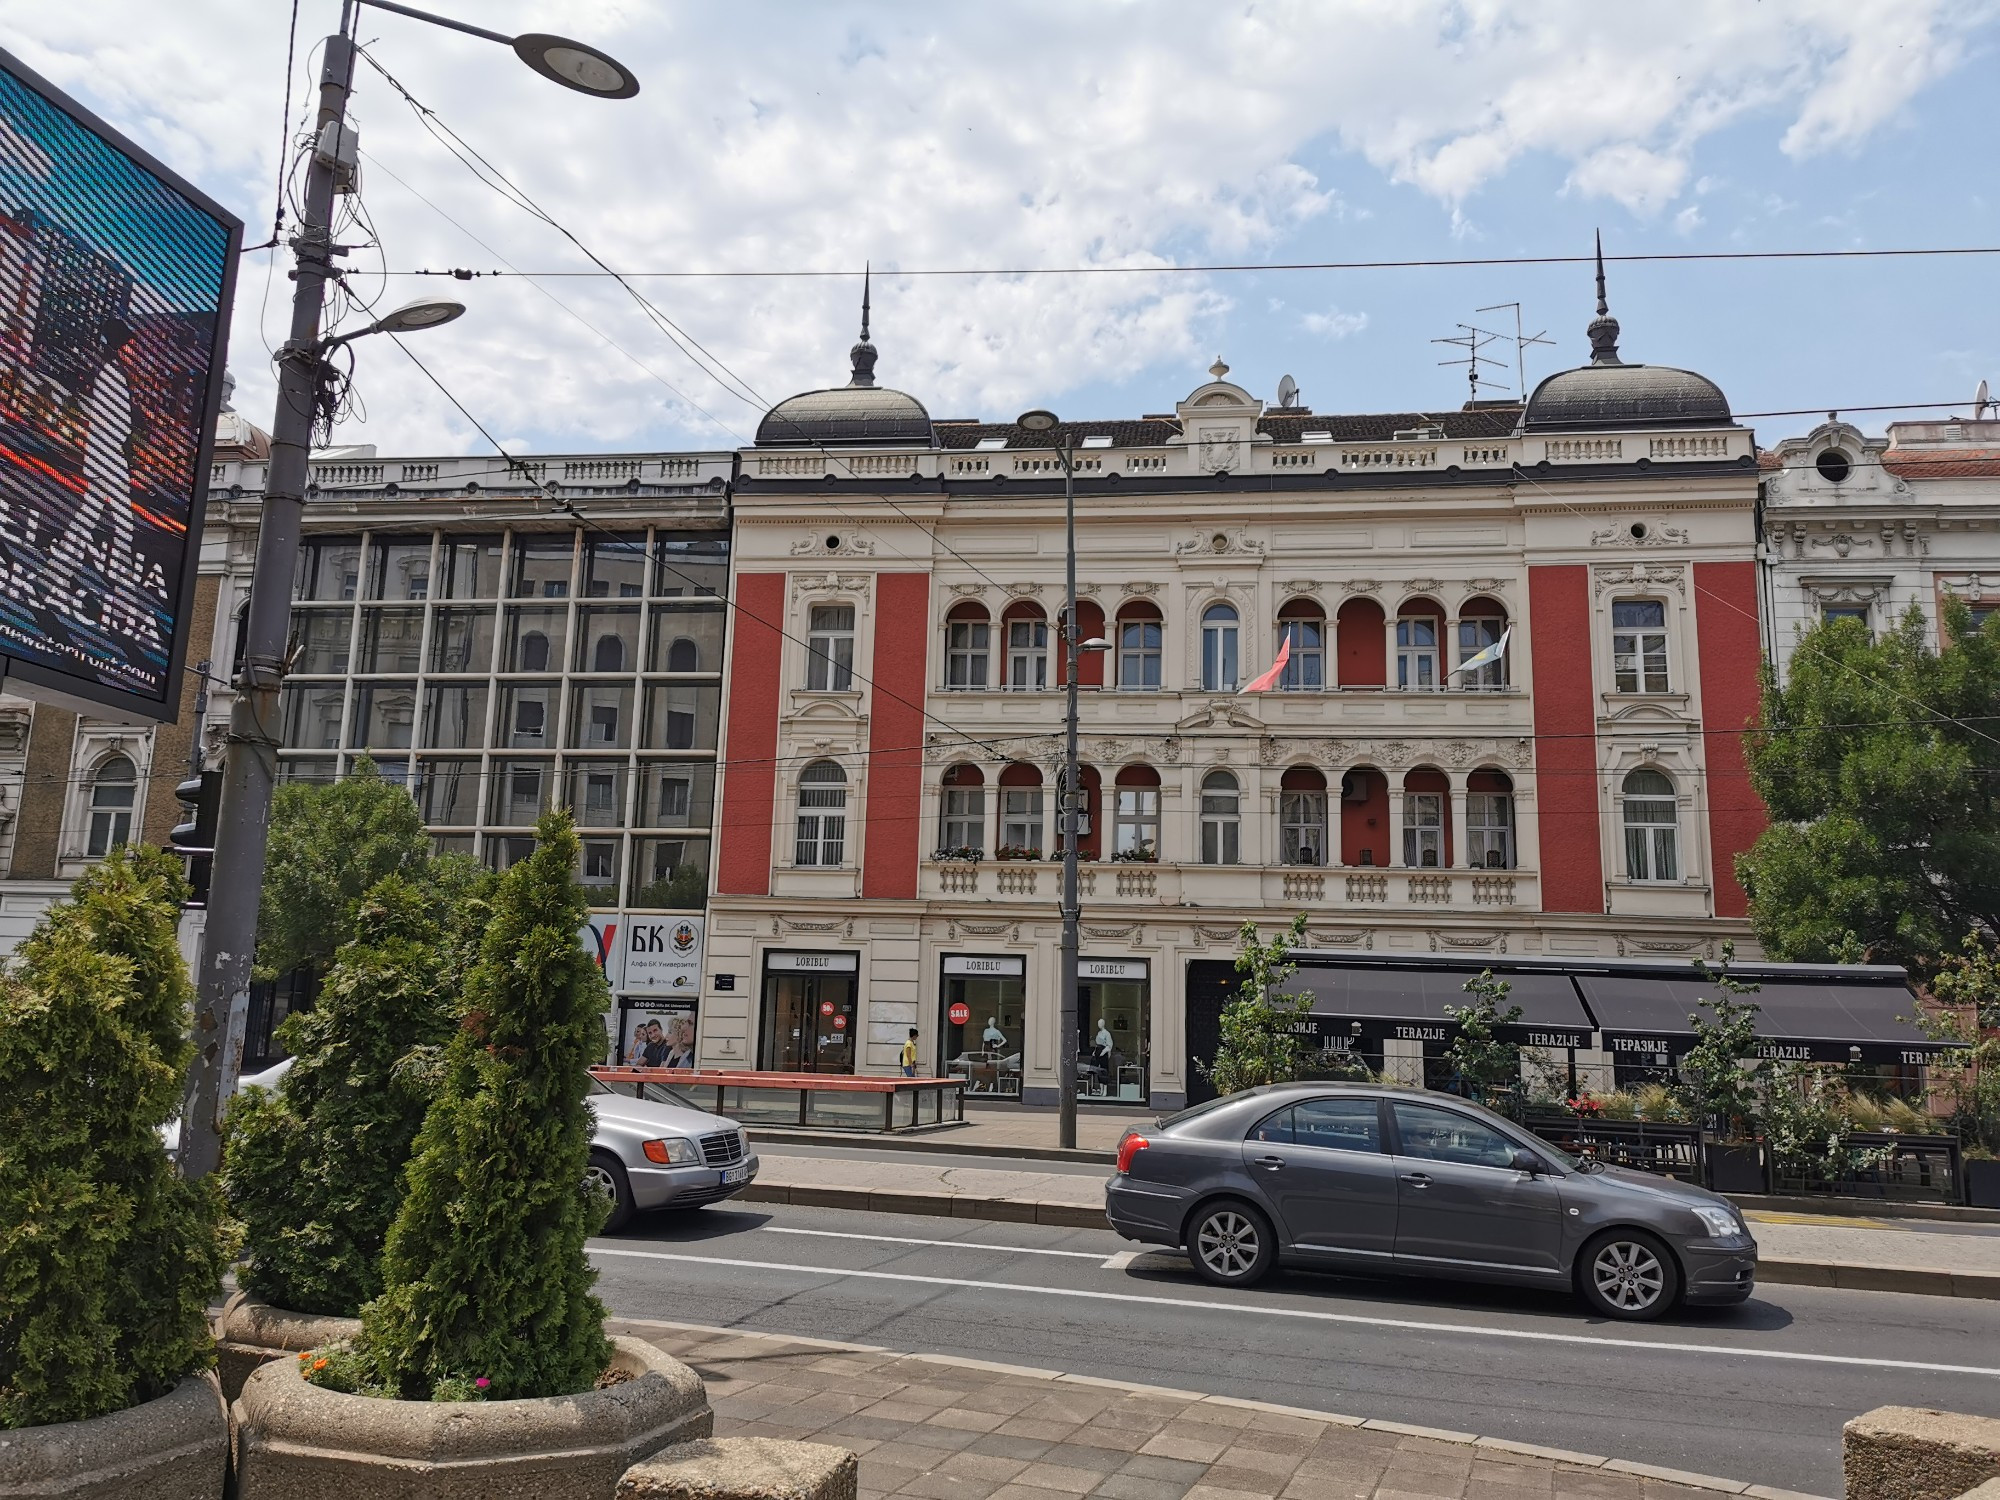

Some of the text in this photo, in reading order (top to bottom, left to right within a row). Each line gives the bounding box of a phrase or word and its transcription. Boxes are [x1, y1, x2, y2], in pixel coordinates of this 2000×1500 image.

[632, 925, 664, 952] БК
[631, 960, 648, 968] Алфа
[658, 961, 698, 969] Универзитет
[796, 957, 829, 968] LORIBLU
[966, 961, 1001, 971] LORIBLU
[1090, 963, 1125, 974] LORIBLU
[950, 1010, 968, 1018] SALE
[1396, 1026, 1446, 1040] TERAZIJE
[1528, 1033, 1580, 1047] TERAZIJE
[1613, 1038, 1668, 1053] ТЕРАЗИЈЕ
